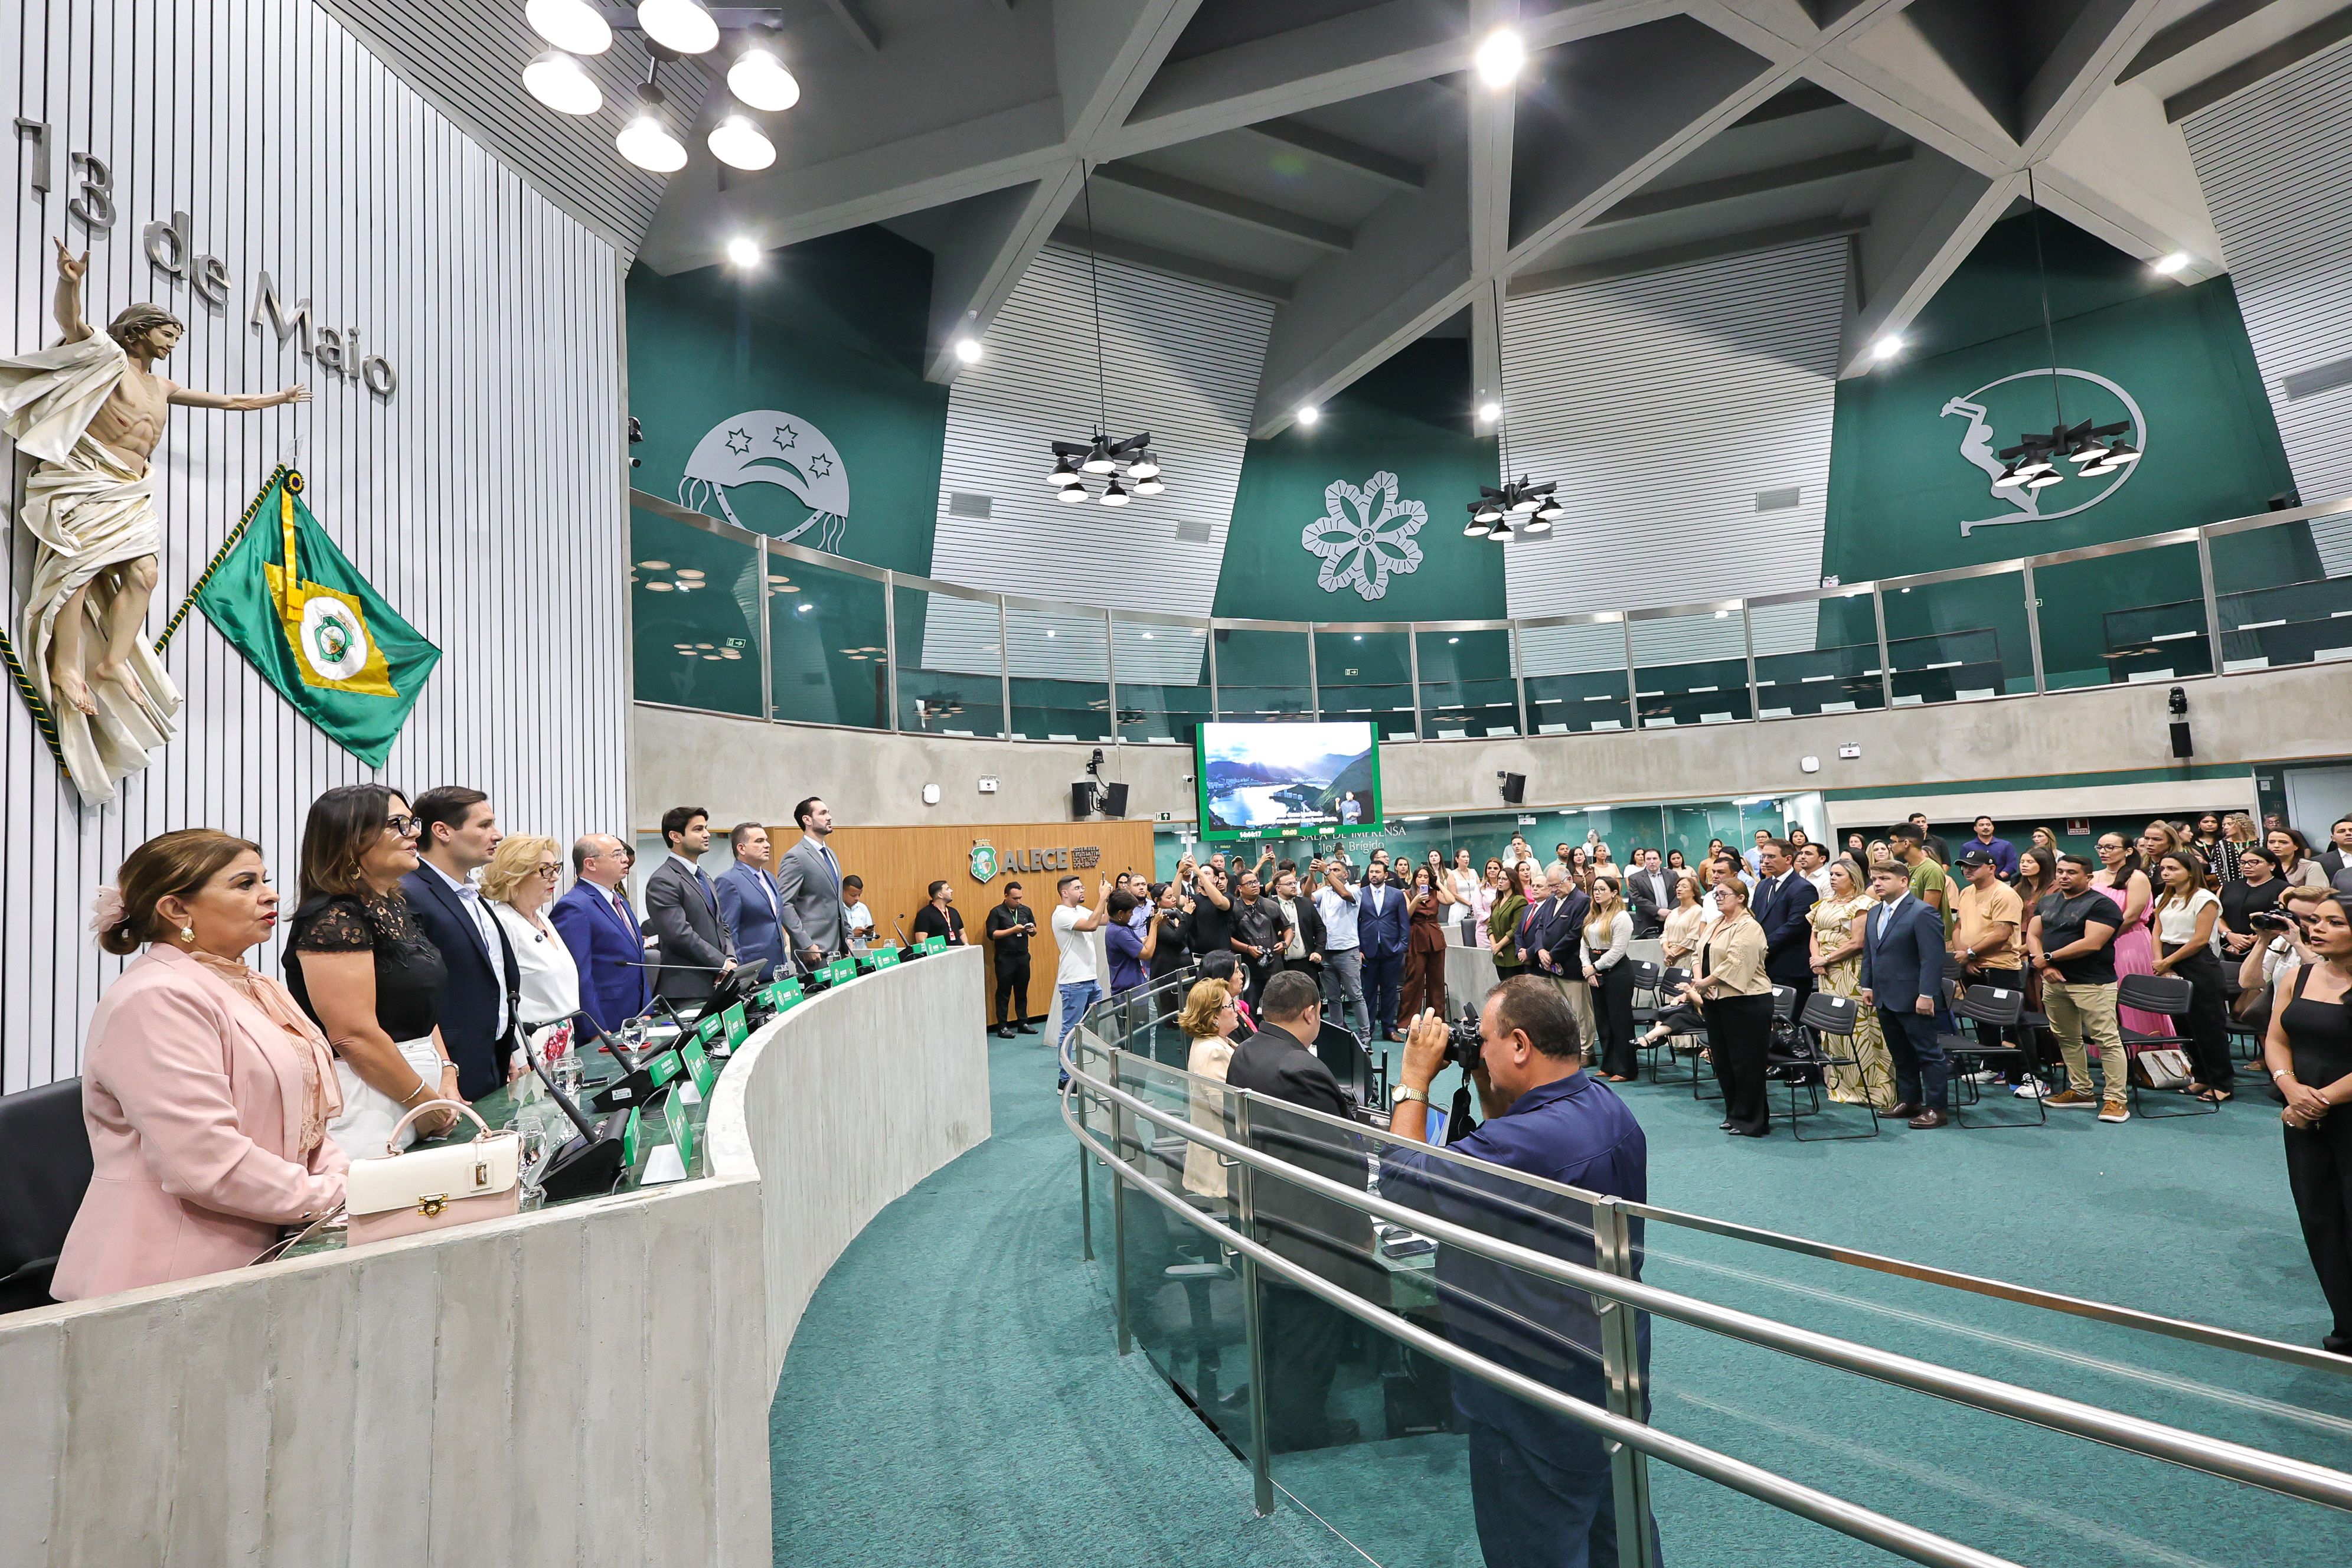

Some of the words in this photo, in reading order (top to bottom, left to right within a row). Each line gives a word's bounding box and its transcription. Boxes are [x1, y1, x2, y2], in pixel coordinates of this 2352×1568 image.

[14, 117, 116, 228] 13
[143, 211, 232, 306] de
[251, 270, 397, 396] Maio
[1000, 847, 1069, 873] ALECE
[1348, 839, 1385, 855] Brígido
